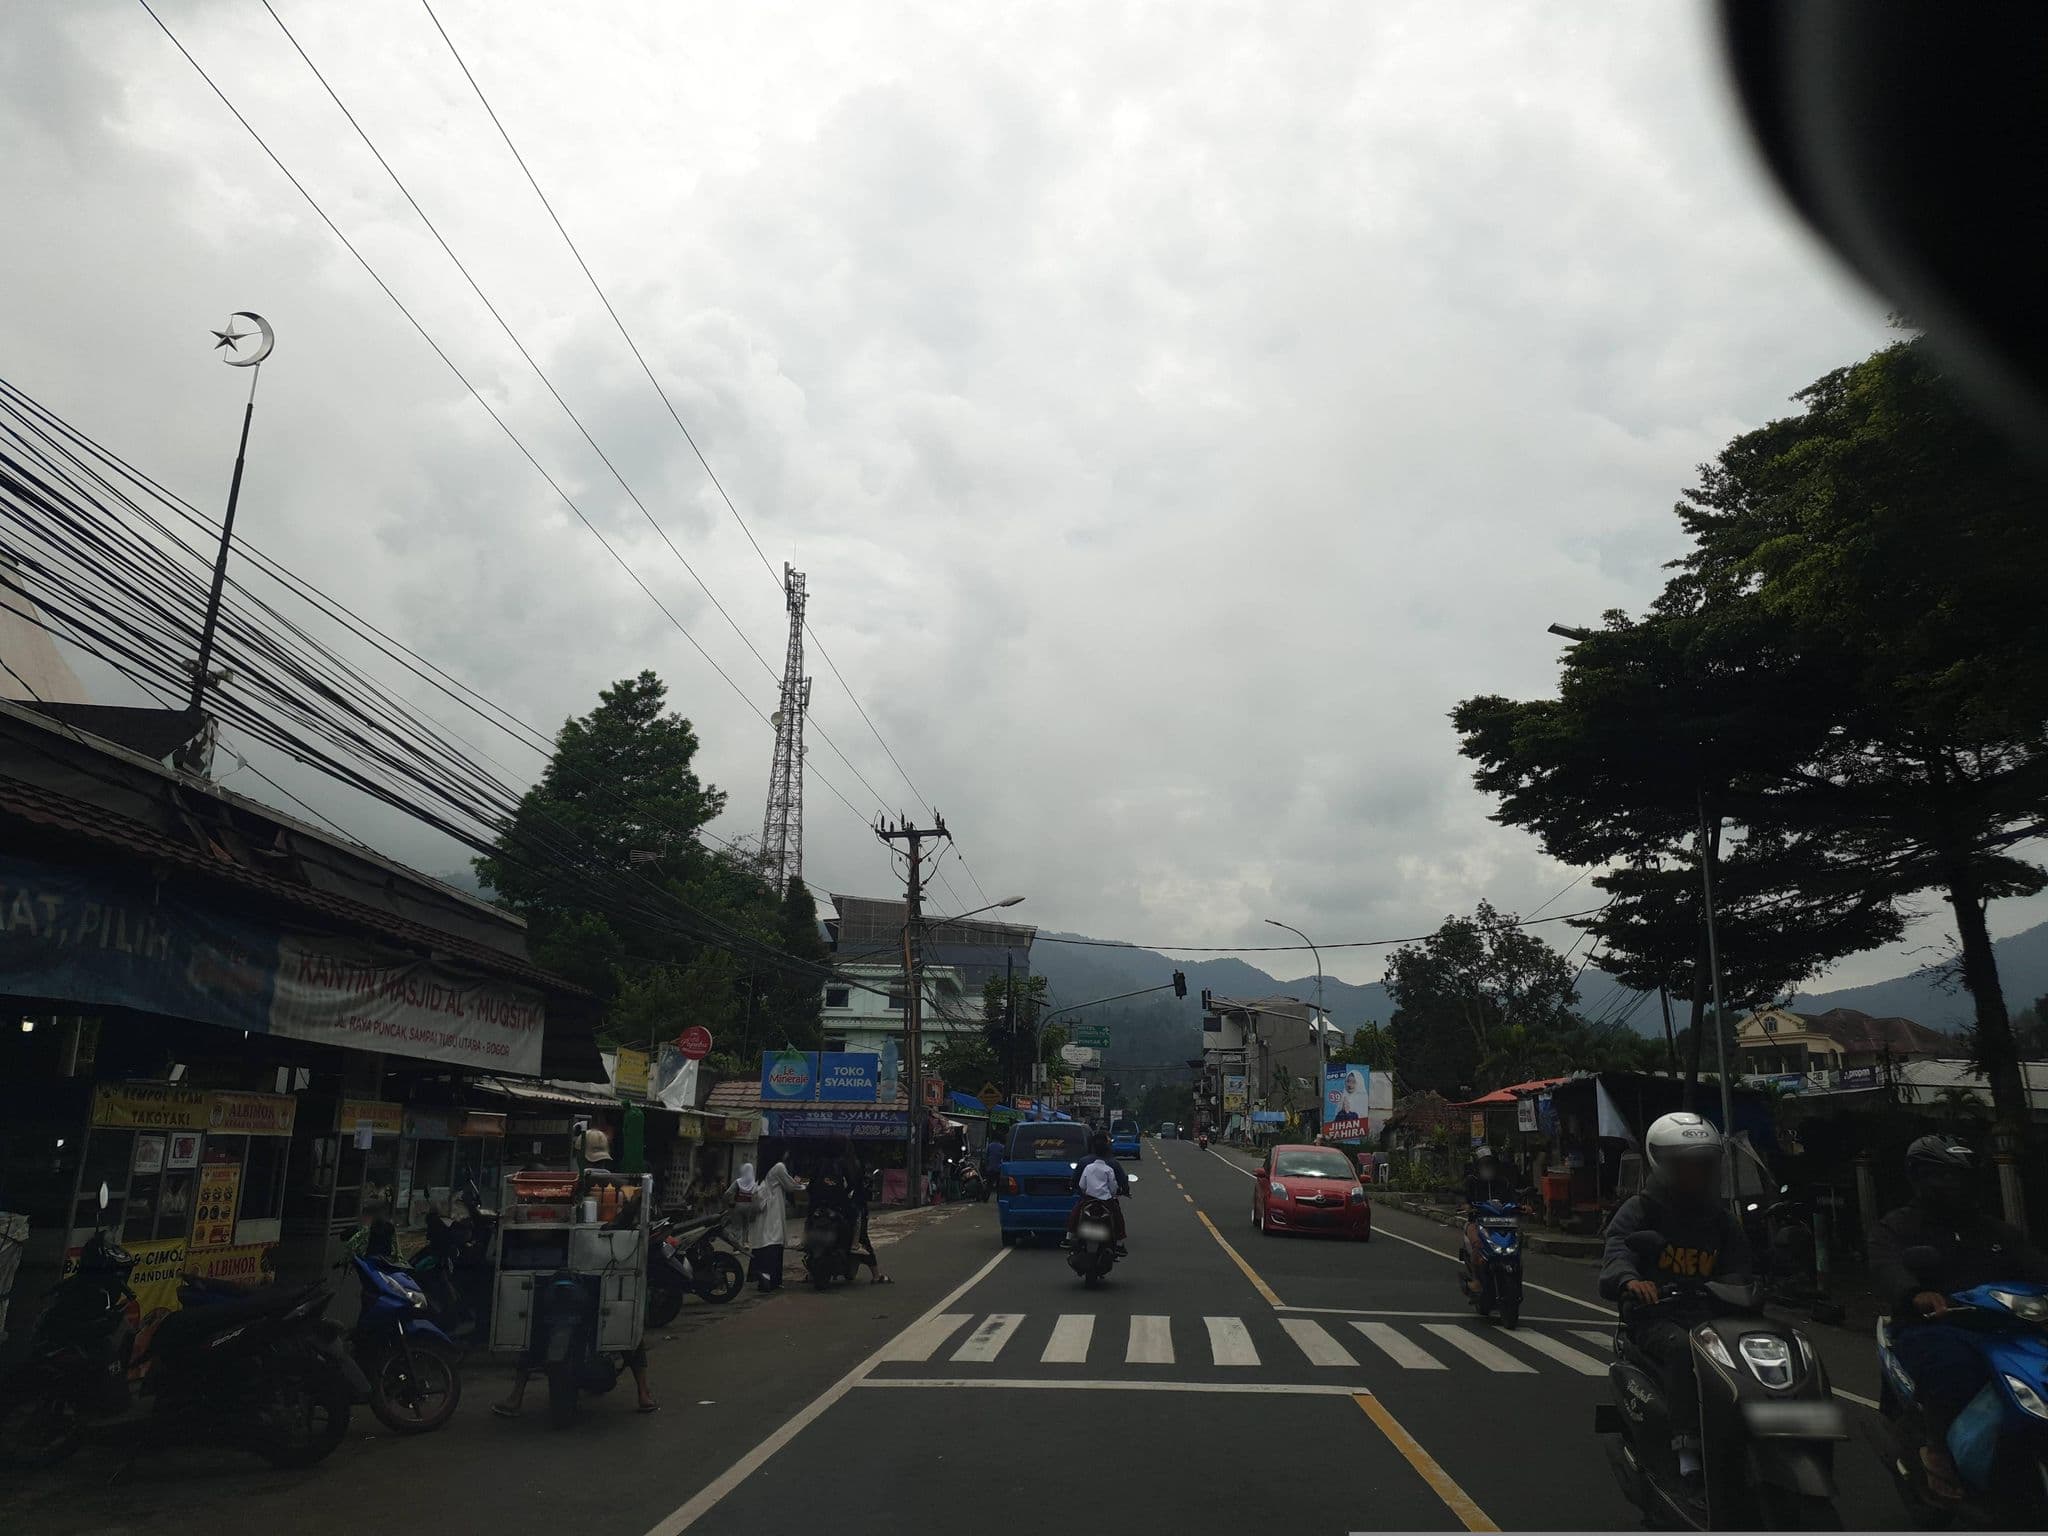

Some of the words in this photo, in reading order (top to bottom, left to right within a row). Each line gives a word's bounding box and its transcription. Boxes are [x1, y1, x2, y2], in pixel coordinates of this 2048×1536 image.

[298, 953, 377, 995] KANTIN
[379, 968, 441, 1011] MASJID
[445, 989, 464, 1016] AL
[350, 1016, 371, 1033] RAYA
[487, 1041, 510, 1057] BOGOR
[834, 1066, 865, 1076] TOKO
[825, 1077, 872, 1088] SYAKIRA
[131, 1111, 190, 1126] TAKOYAKI
[839, 1110, 898, 1121] SYAKIRA
[1328, 1120, 1360, 1131] JIHAN
[1328, 1128, 1366, 1139] FAHIRA
[146, 1249, 184, 1266] CIMOL
[207, 1256, 256, 1278] ALBIMOR
